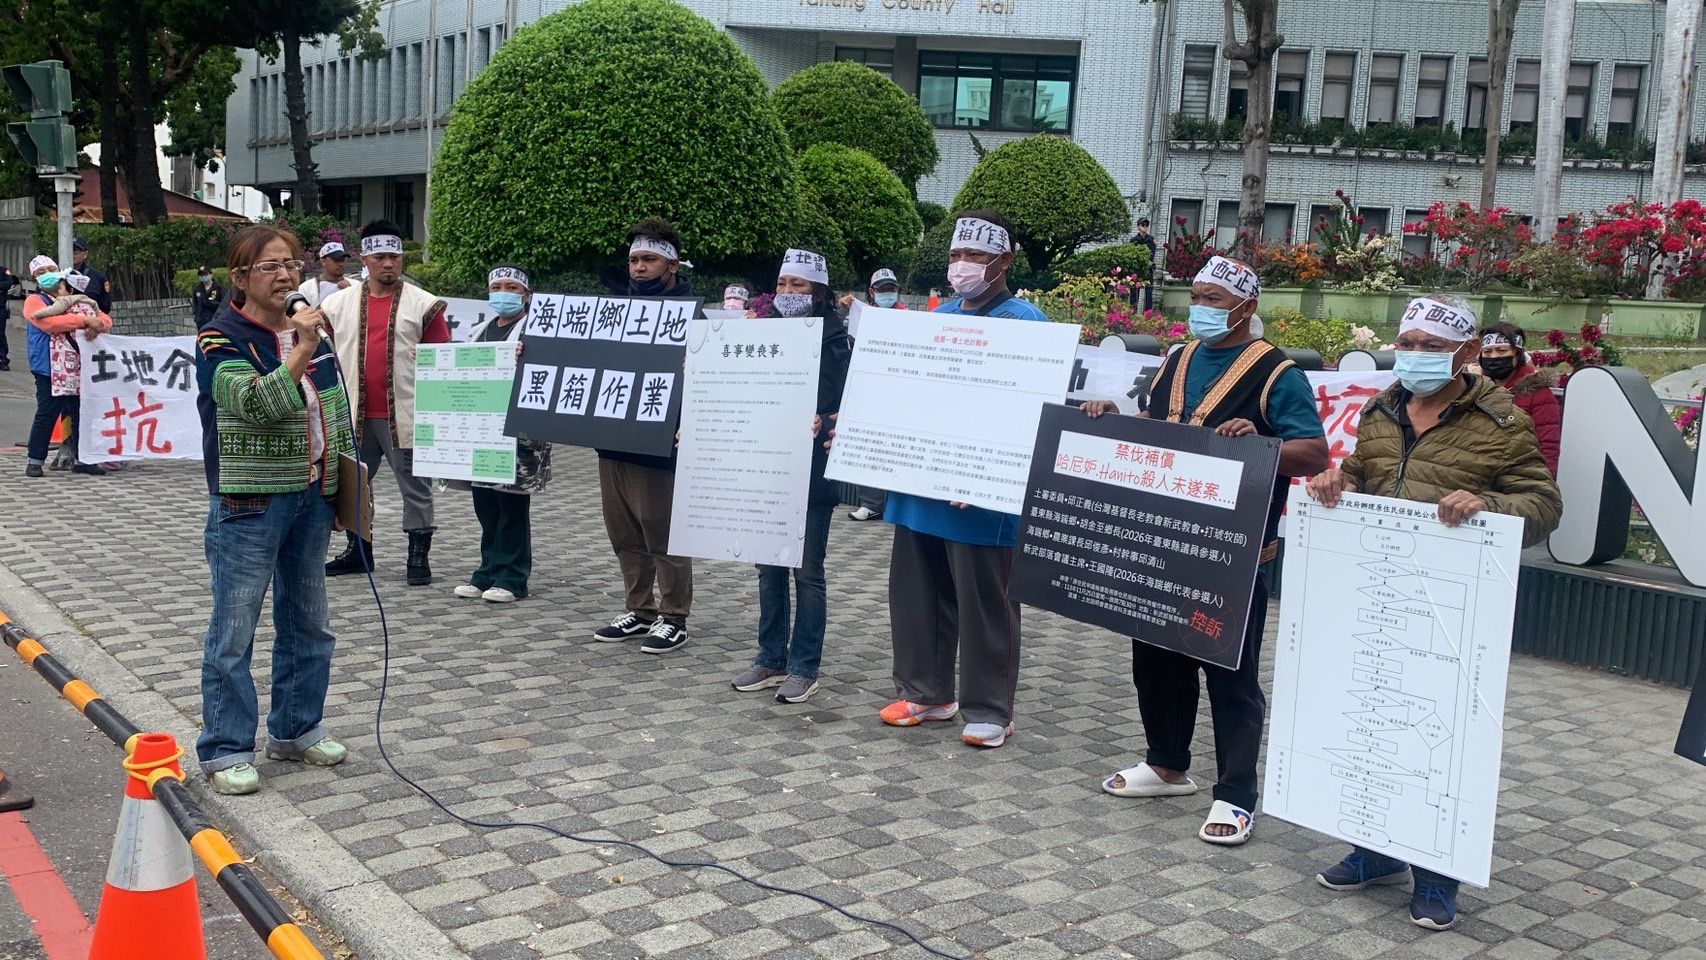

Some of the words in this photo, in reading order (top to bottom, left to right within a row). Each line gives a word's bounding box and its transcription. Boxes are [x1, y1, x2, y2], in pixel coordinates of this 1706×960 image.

[529, 296, 688, 343] 海端鄉土地
[91, 348, 197, 392] 土地分
[721, 343, 780, 358] 喜事變喪事
[521, 370, 668, 417] 黑箱作業
[101, 391, 173, 456] 抗
[1115, 442, 1176, 470] 禁伐補償
[1189, 606, 1225, 642] 控訴
